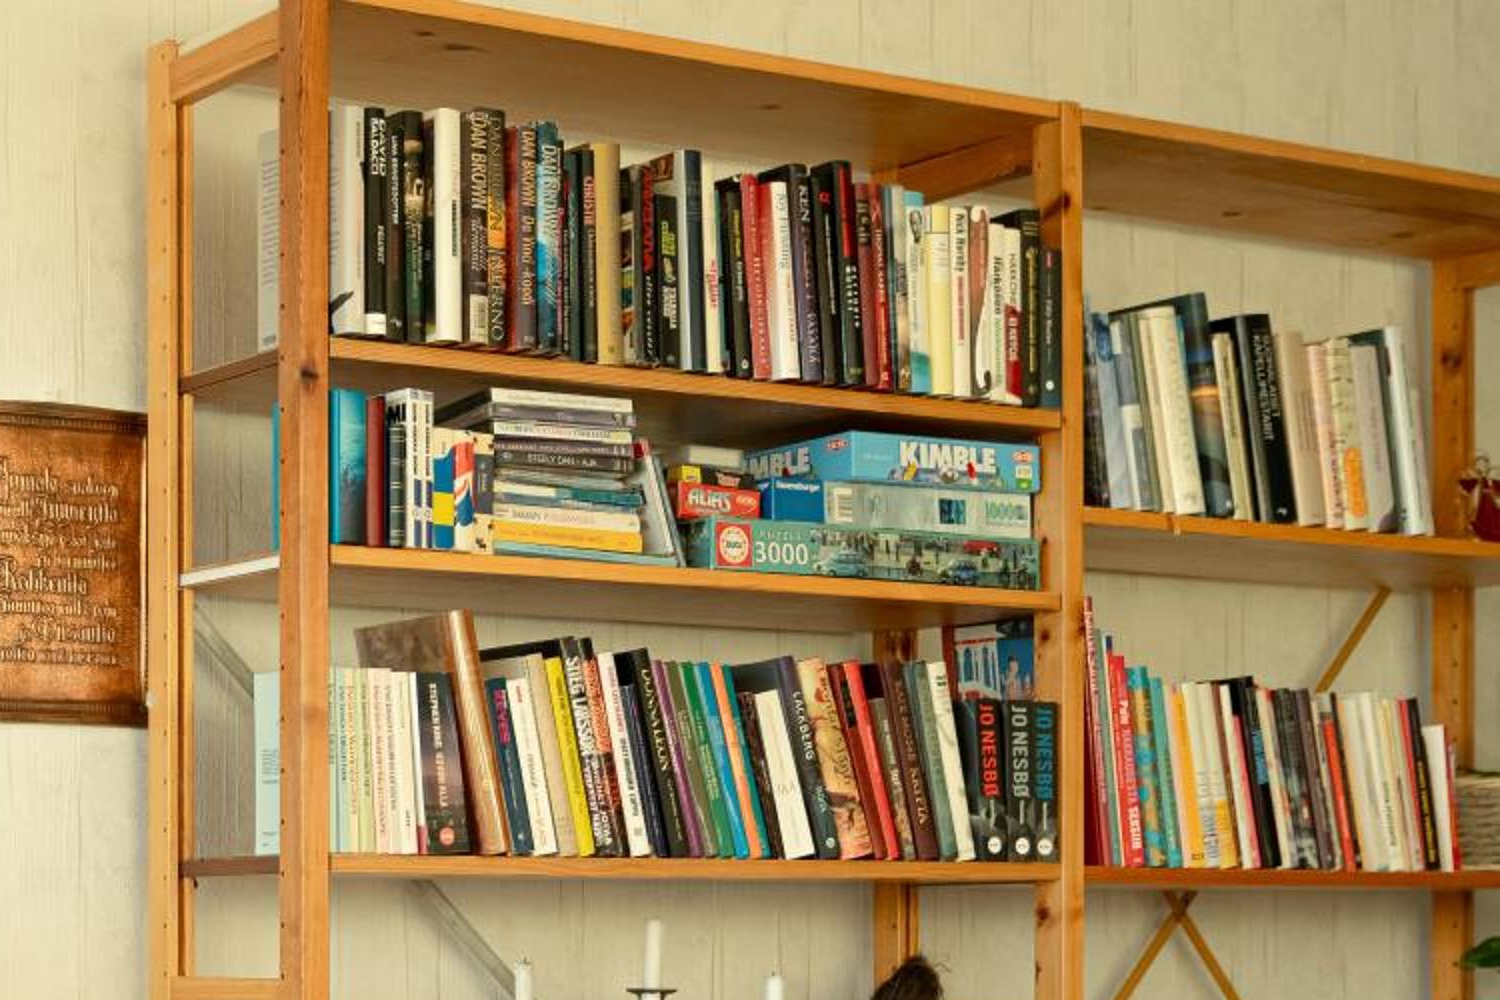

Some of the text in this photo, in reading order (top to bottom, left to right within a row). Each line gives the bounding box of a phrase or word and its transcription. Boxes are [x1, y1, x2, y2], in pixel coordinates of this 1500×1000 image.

[370, 117, 379, 176] BALDACCI
[378, 118, 387, 177] DAVID
[471, 117, 488, 211] DAN BROWN
[522, 131, 535, 155] DAN
[521, 159, 536, 207] BROWN
[541, 145, 560, 238] DAN BROWN
[583, 175, 595, 226] CHRISTIE
[798, 185, 812, 223] KEN
[489, 249, 505, 342] INFERNO
[555, 454, 578, 467] DAN
[900, 441, 997, 473] KIMBLE
[754, 542, 809, 566] 3000
[565, 656, 597, 756] STIEG LARSSON
[641, 669, 671, 773] DONNA LEON
[978, 704, 1000, 798] JO NESBØ
[1011, 706, 1030, 799] JO NESBØ
[1036, 706, 1055, 800] JO NESBØ
